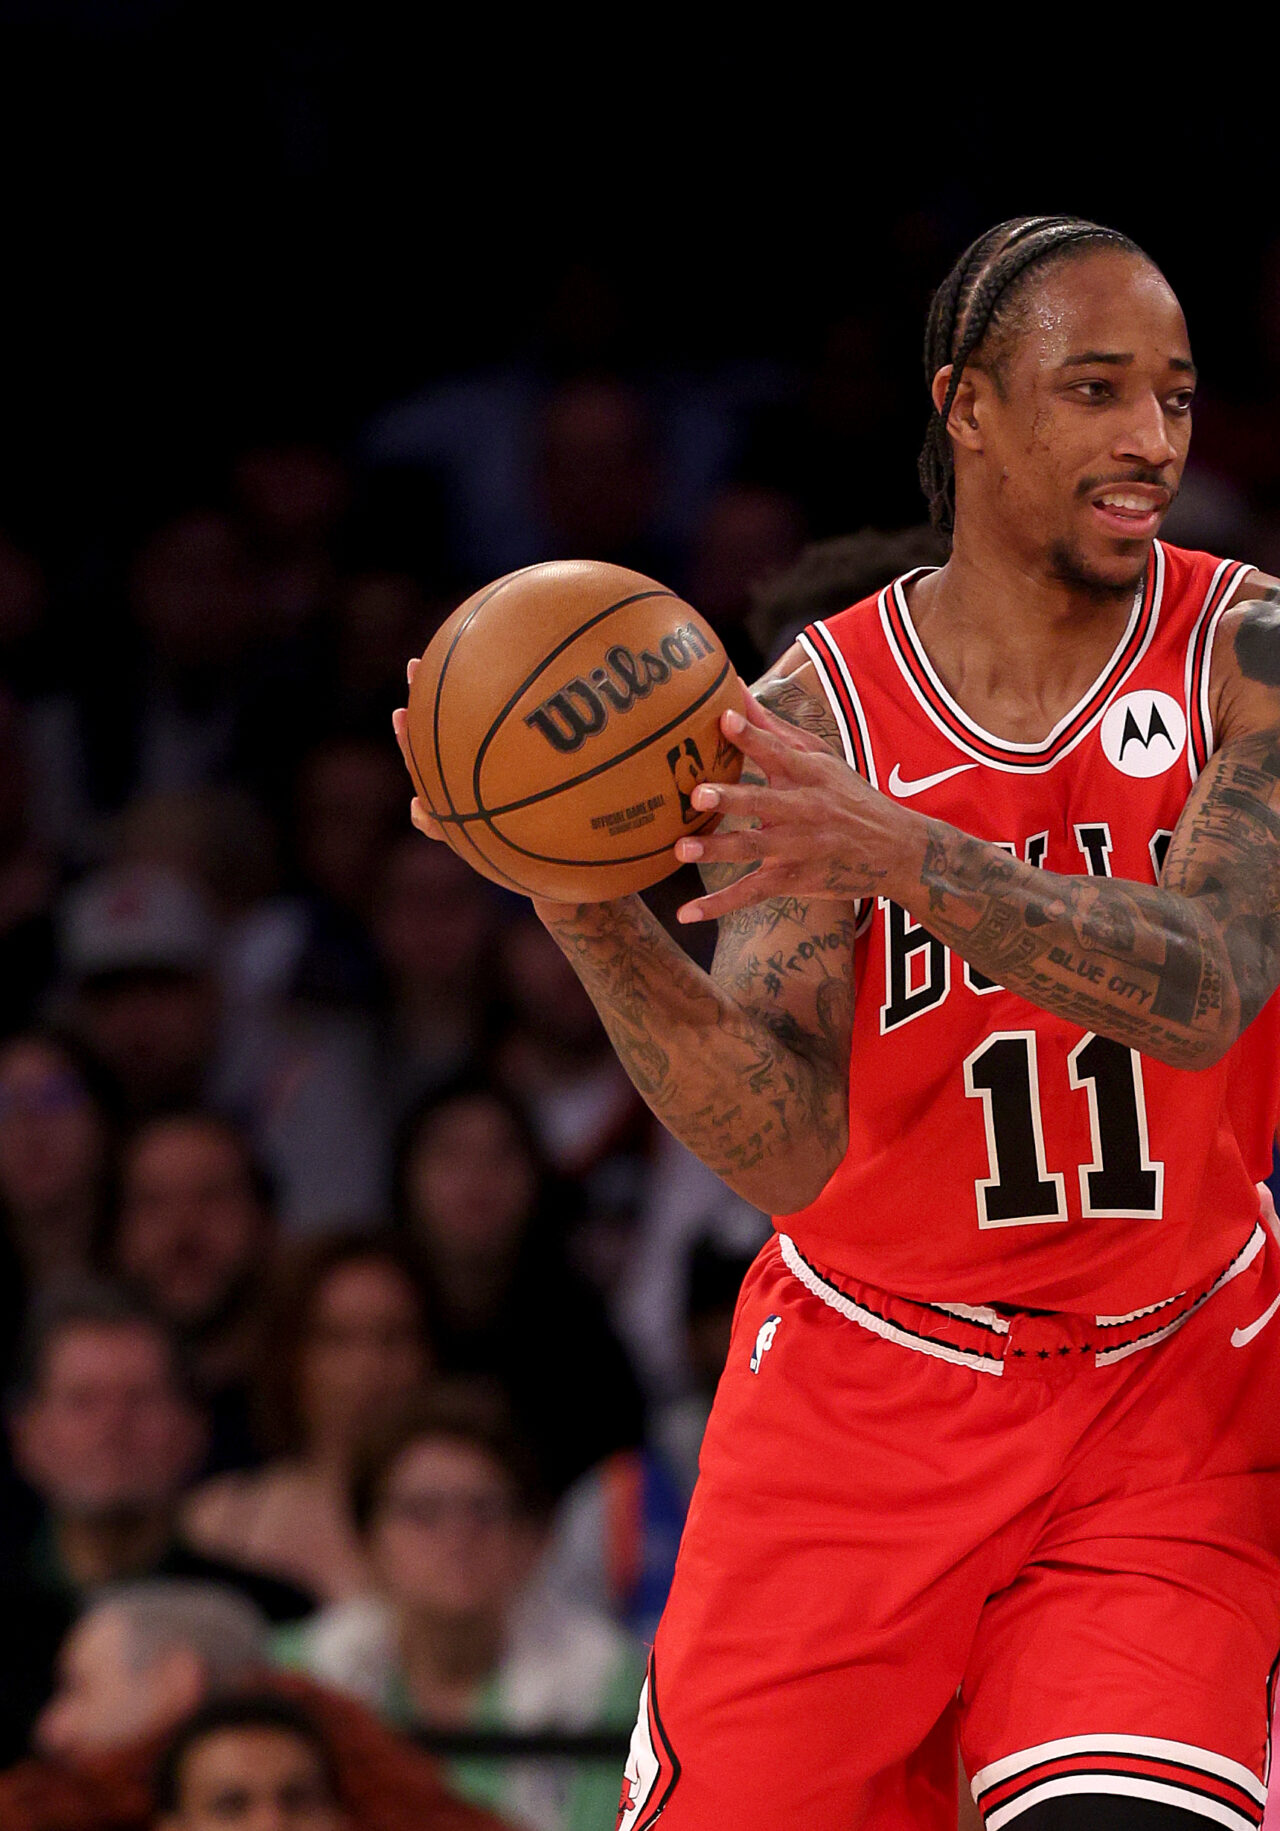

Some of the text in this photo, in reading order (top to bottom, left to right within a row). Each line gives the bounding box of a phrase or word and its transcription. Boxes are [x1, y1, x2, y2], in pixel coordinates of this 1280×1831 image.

[522, 622, 715, 754] Wilson
[1047, 946, 1105, 985] BLUE
[1108, 975, 1153, 1006] CITY
[963, 1031, 1165, 1230] 11
